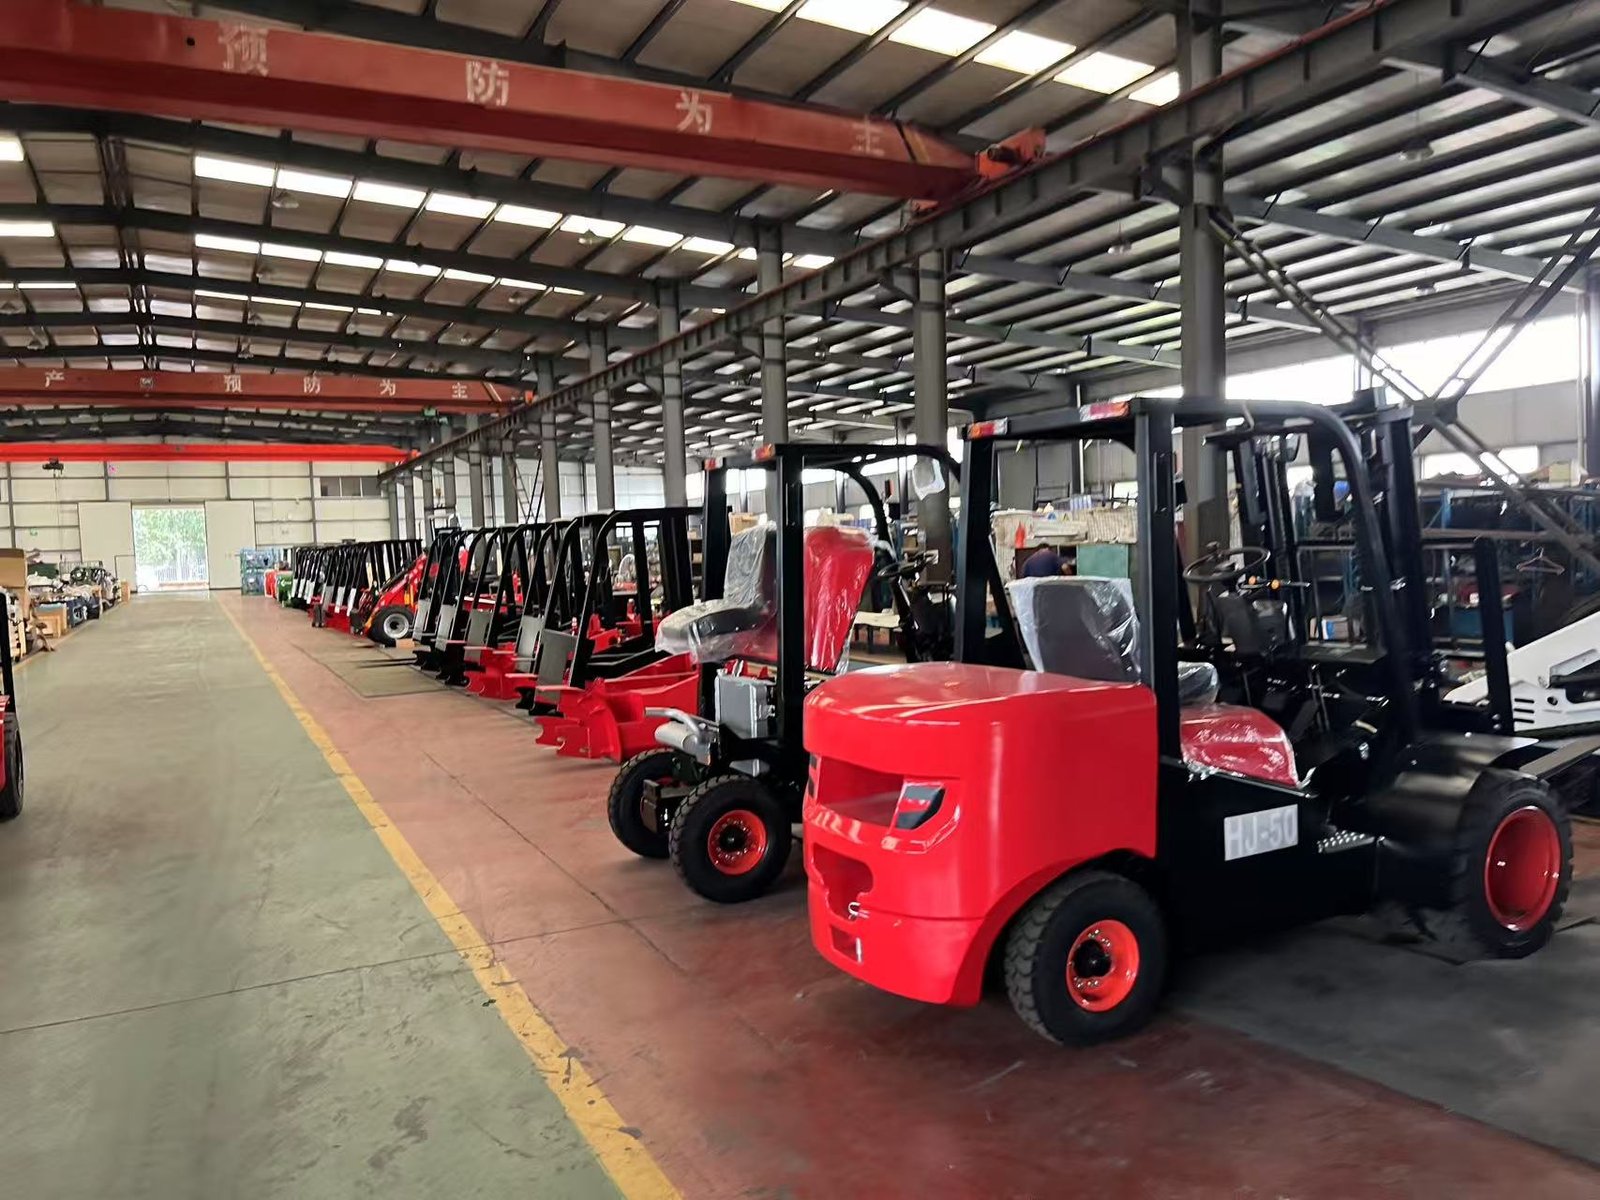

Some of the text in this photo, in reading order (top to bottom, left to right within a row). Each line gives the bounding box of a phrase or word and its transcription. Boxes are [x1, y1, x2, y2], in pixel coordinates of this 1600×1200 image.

[218, 23, 885, 157] 预防为主
[45, 369, 65, 388] 产
[1225, 807, 1298, 859] HJ-50
